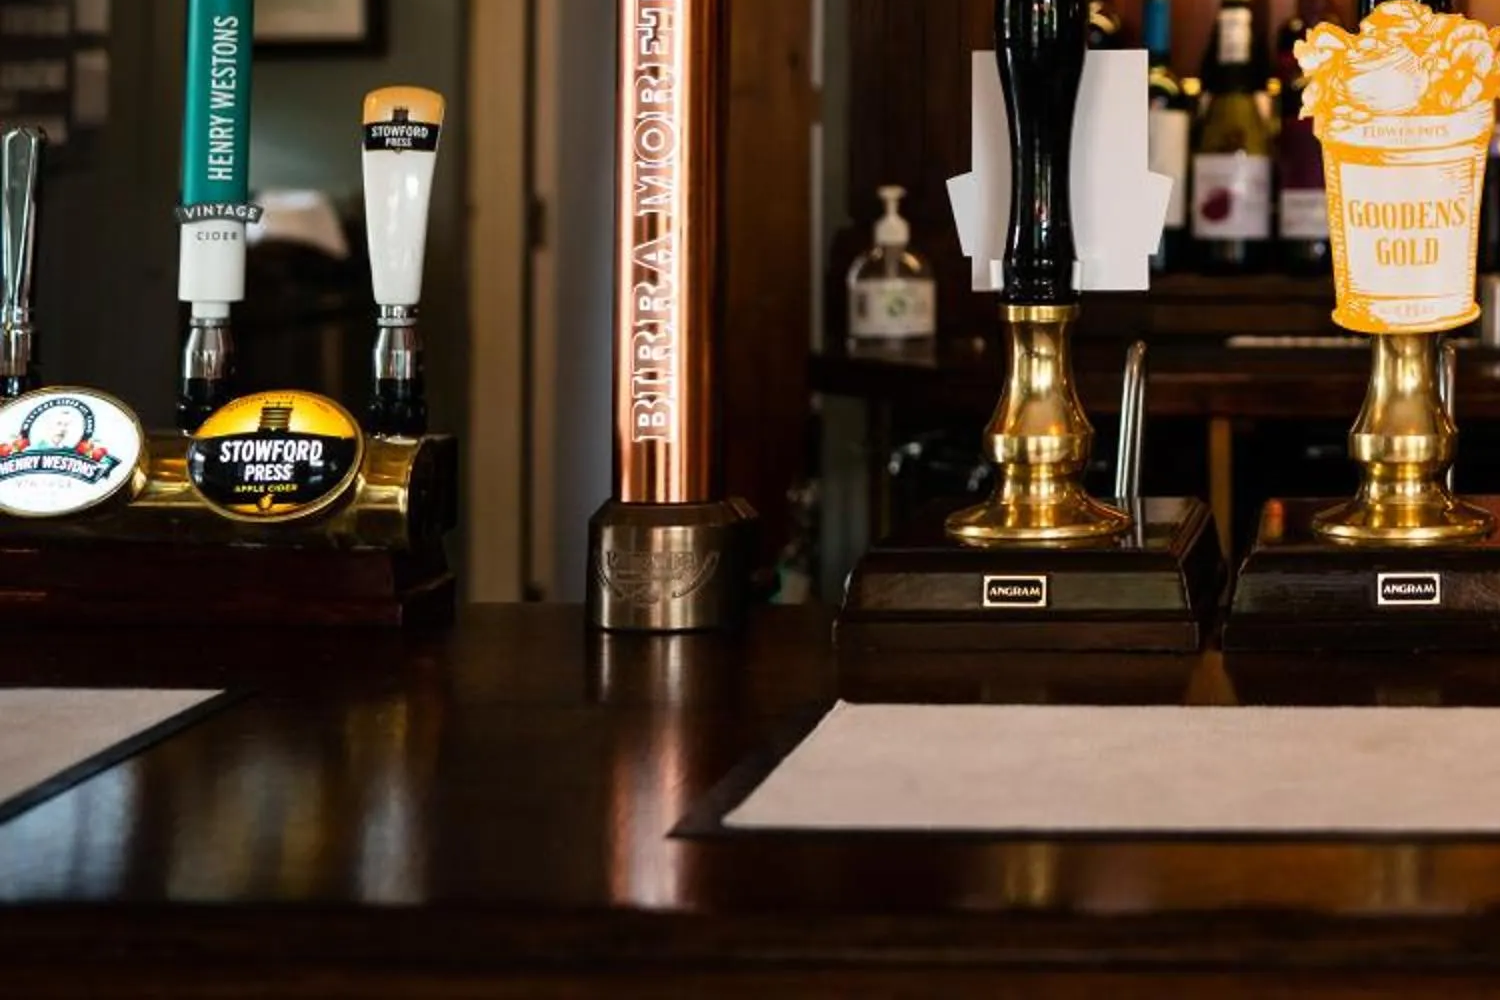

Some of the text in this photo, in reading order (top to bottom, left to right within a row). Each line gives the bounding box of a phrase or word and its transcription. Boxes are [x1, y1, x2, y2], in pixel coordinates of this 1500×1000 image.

[207, 15, 239, 181] HENRY WESTONS
[371, 125, 429, 138] STOWFORD
[385, 137, 413, 148] PRESS
[184, 203, 258, 220] VINTAGE
[1349, 200, 1467, 230] GOODENS
[196, 231, 239, 242] CIDER
[1375, 237, 1440, 267] GOLD
[633, 238, 679, 443] BIRRA
[219, 439, 325, 467] STOWFORD
[0, 455, 97, 479] HENRY WESTONS
[243, 463, 295, 482] PRESS
[234, 483, 298, 493] APPLE CIDER
[989, 585, 1041, 597] ANGRAM
[1383, 583, 1435, 595] ANGRAM
